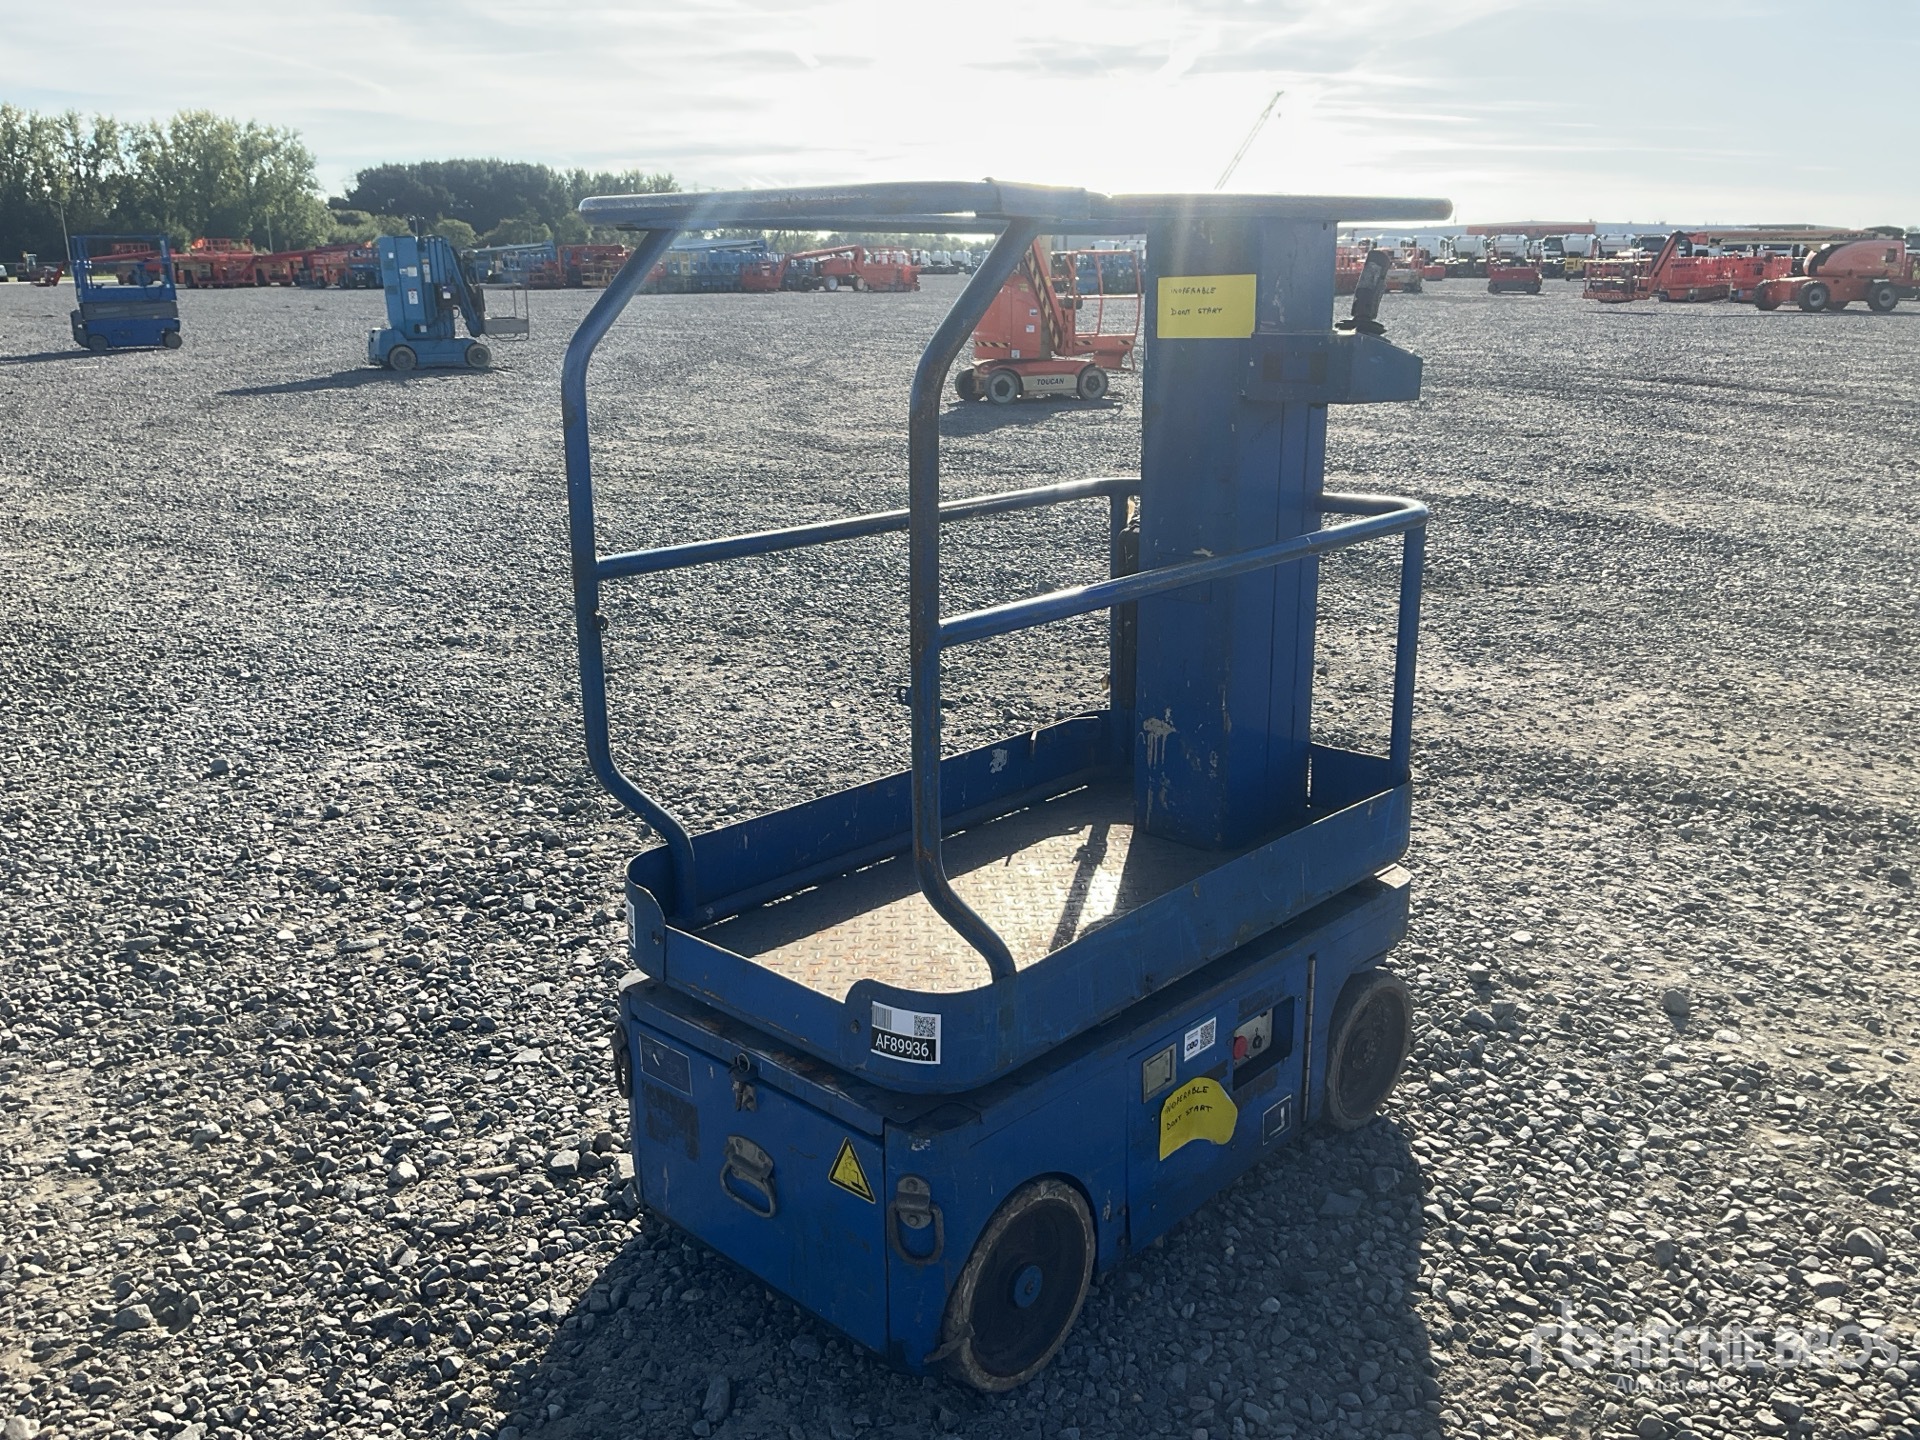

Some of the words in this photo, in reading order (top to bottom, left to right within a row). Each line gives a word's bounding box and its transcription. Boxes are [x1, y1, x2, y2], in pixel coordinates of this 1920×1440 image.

[1170, 286, 1217, 295] INOPERABLE
[1170, 307, 1191, 316] DONT
[1036, 377, 1065, 386] TOUCAN
[876, 1032, 930, 1057] AF89936
[1166, 1115, 1183, 1131] DONT
[1185, 1104, 1213, 1117] START
